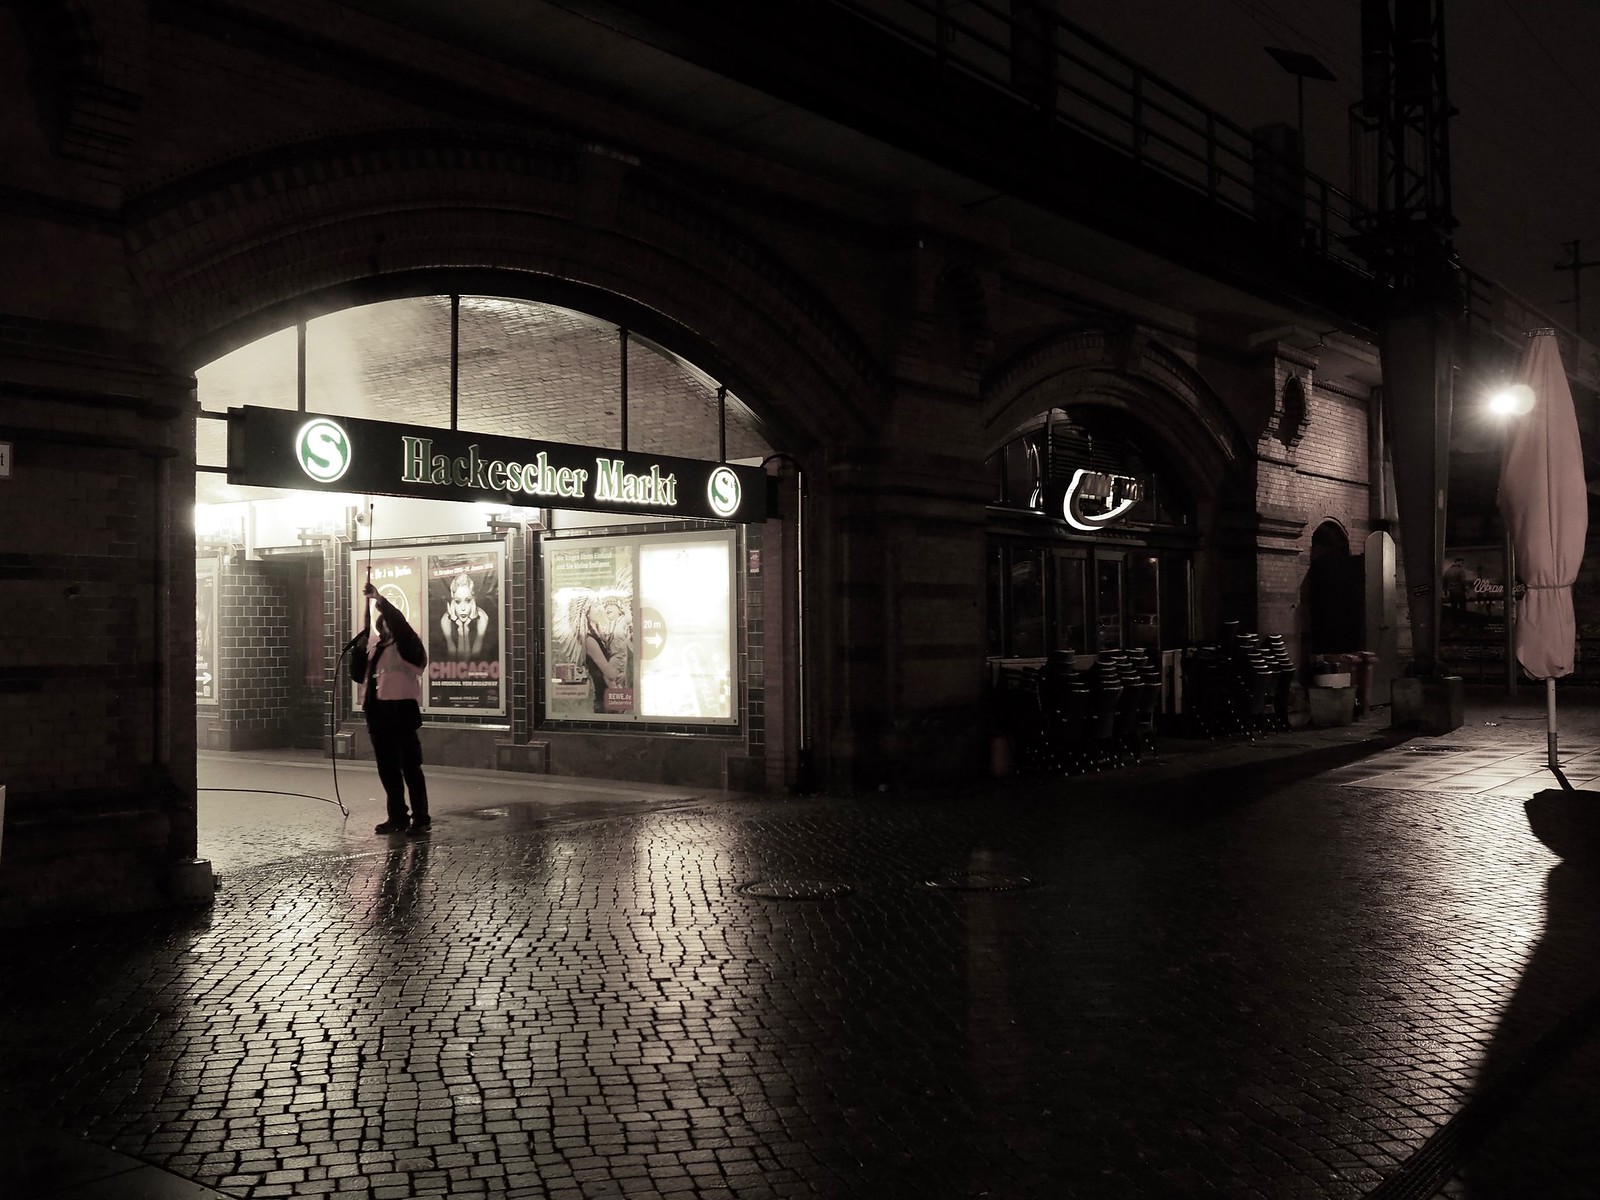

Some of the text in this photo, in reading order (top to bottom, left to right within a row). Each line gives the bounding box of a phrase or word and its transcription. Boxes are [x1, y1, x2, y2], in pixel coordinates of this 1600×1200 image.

[305, 422, 347, 479] S
[401, 435, 678, 506] Hackescher Markt
[711, 468, 739, 513] S
[643, 620, 661, 629] 20 m
[429, 660, 499, 680] CHICAGO
